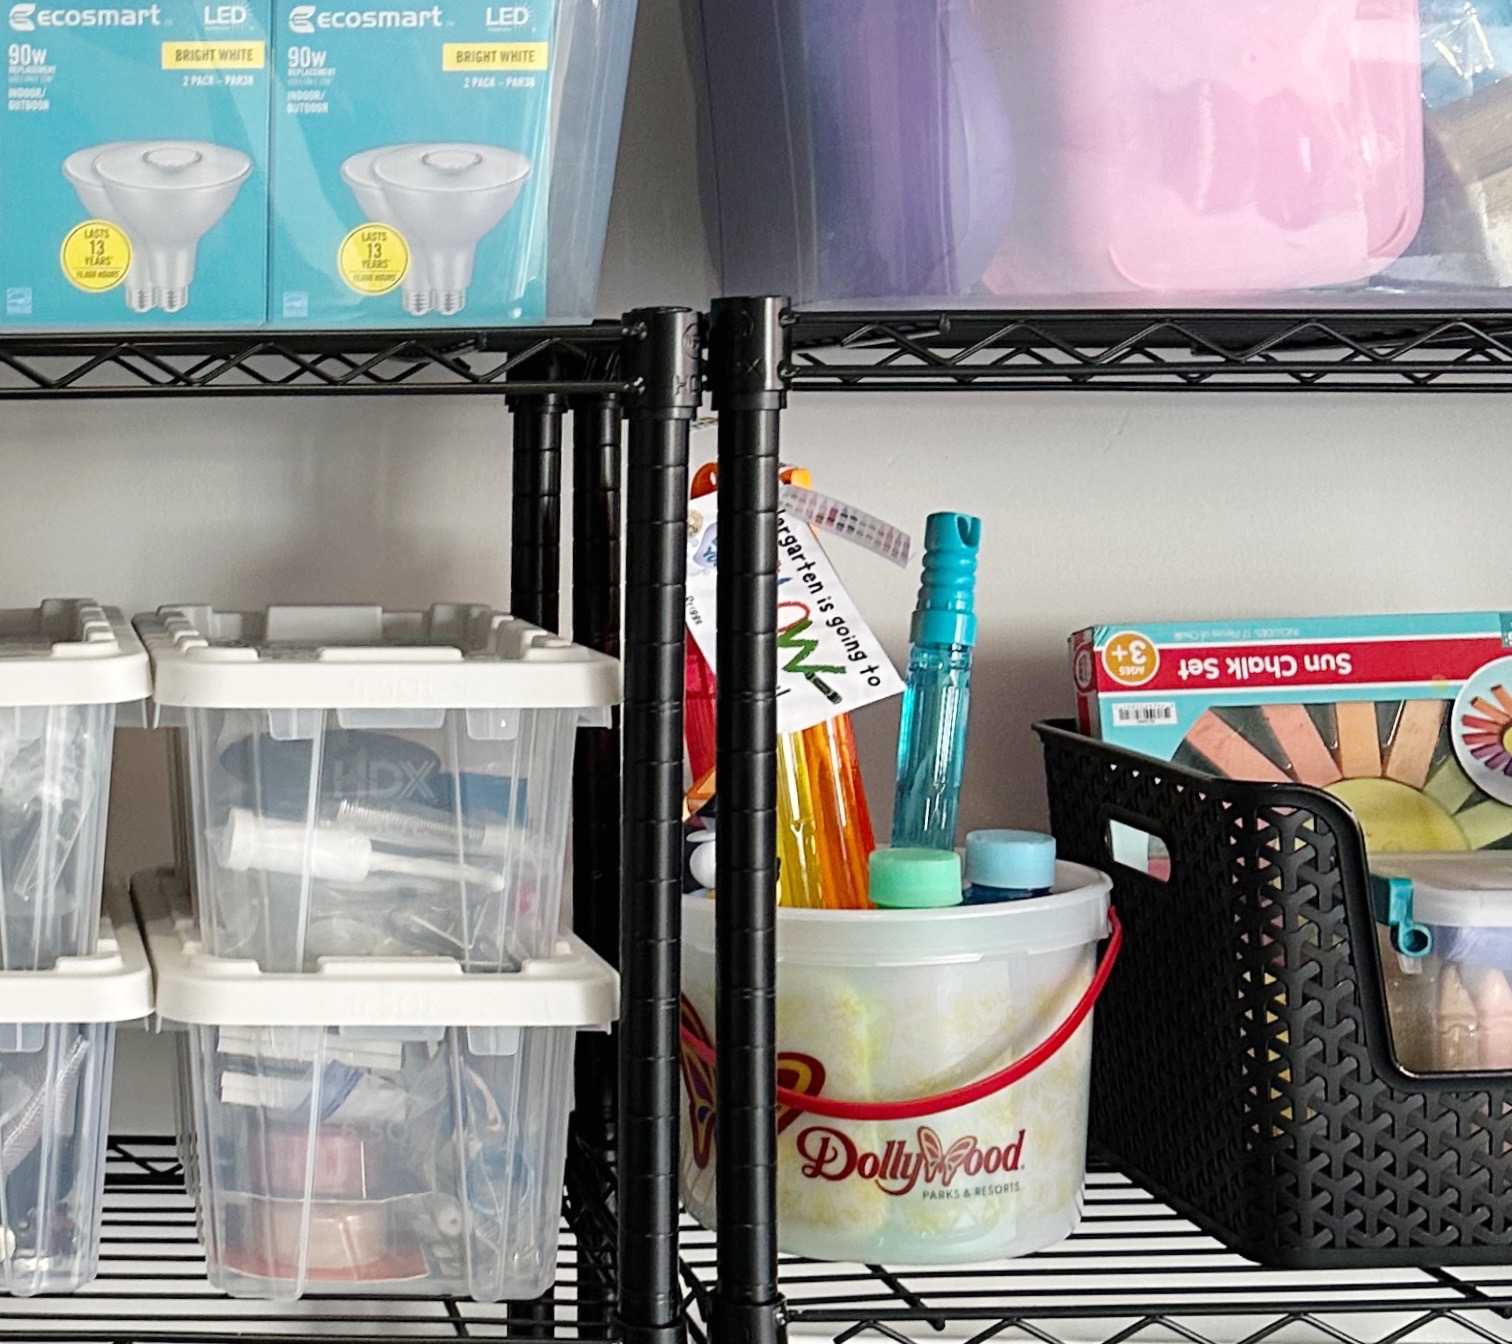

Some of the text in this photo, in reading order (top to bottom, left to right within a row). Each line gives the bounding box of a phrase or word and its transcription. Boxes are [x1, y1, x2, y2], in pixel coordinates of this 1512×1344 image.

[37, 5, 162, 28] ecosmart
[203, 6, 247, 25] LED
[317, 7, 443, 28] ecosmart
[486, 8, 529, 26] LED
[8, 45, 47, 65] 90w
[175, 48, 254, 63] BRIGHT WHITE
[288, 47, 327, 67] 90w
[456, 50, 536, 63] BRIGHT WHITE
[183, 76, 190, 86] 2
[190, 76, 215, 87] PACK
[463, 77, 470, 88] 2
[472, 77, 497, 88] PACK
[361, 232, 387, 242] LASTS
[89, 240, 105, 257] 13
[367, 243, 382, 259] 13
[816, 596, 881, 687] is going to
[1111, 639, 1147, 664] 3+
[1119, 665, 1145, 676] AGES
[1177, 653, 1352, 681] Sun Chalk Set
[333, 760, 437, 798] HDX
[922, 1181, 1021, 1201] PARKS & RESORTS
